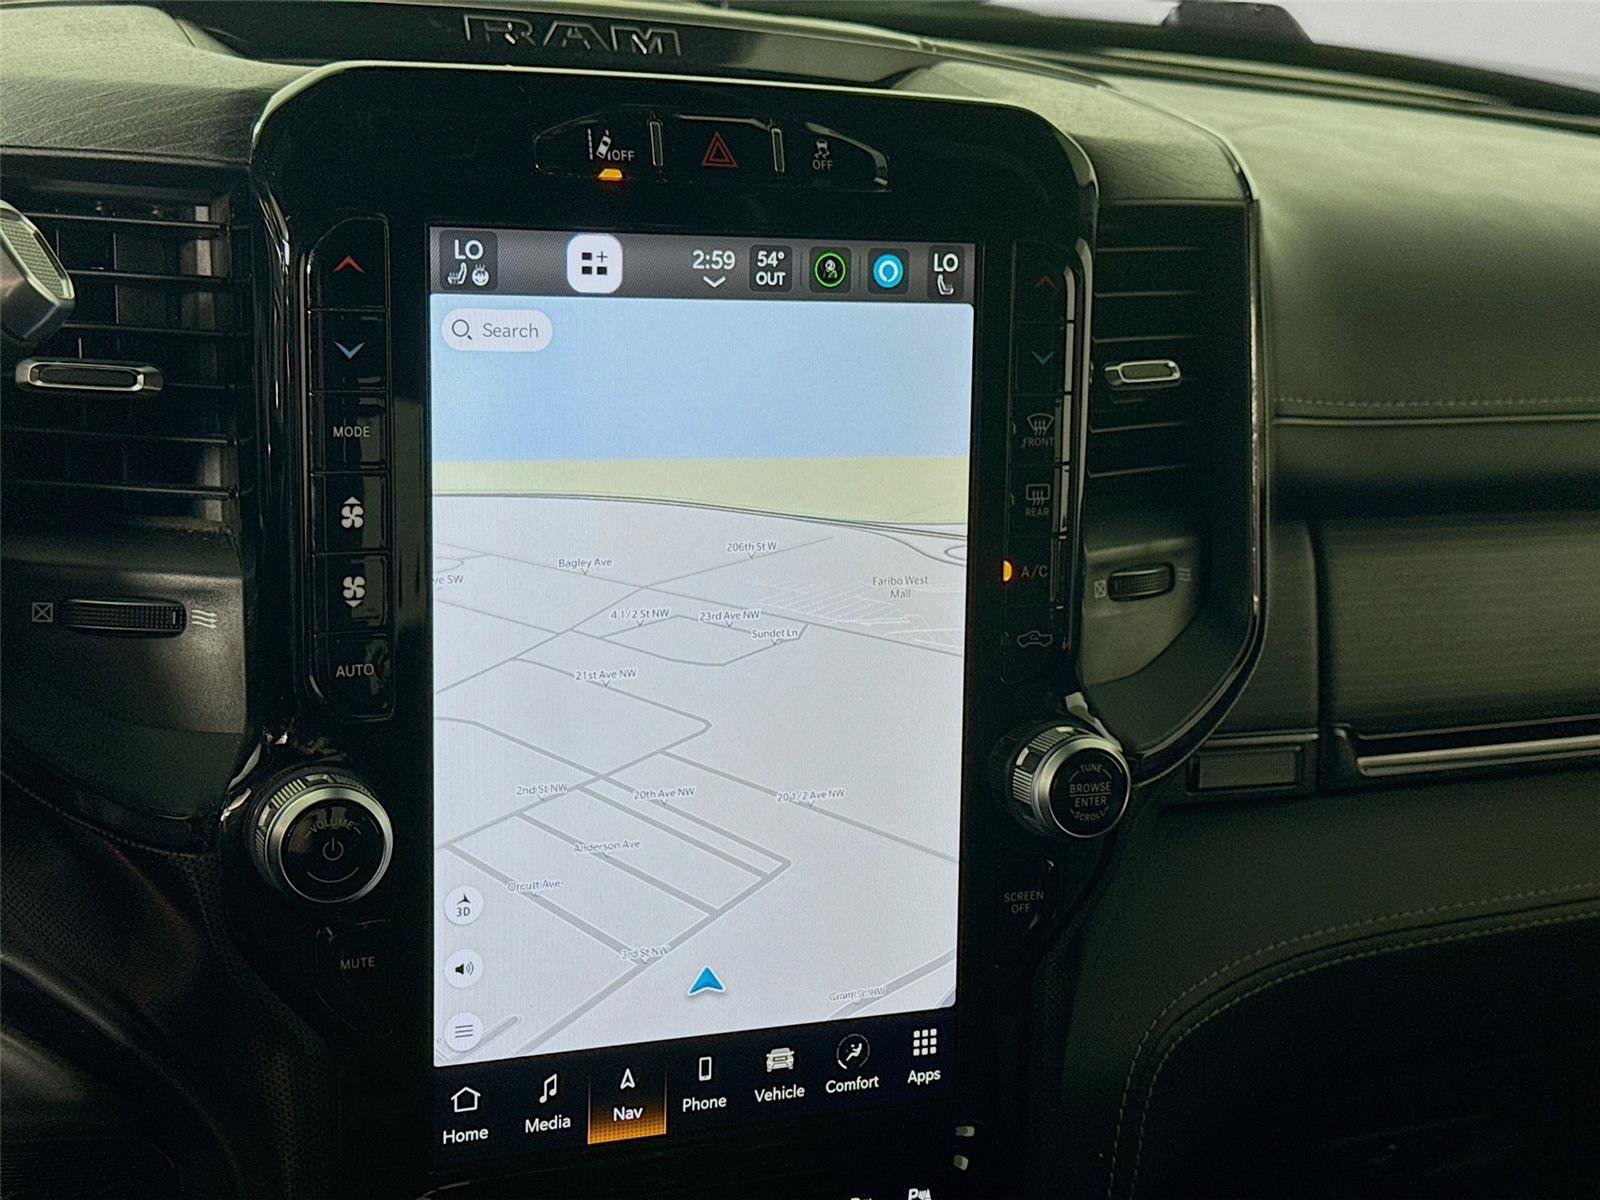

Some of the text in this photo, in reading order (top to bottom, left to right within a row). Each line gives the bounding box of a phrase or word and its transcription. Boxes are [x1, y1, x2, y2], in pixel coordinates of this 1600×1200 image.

[463, 14, 682, 57] RAM
[612, 150, 635, 161] OFF
[812, 158, 834, 170] OFF
[454, 239, 484, 260] LO
[692, 249, 736, 271] 2:59
[756, 250, 785, 268] 54°
[933, 252, 959, 273] LO
[755, 271, 786, 287] OUT
[482, 321, 540, 340] Search
[332, 426, 371, 438] MODE
[1023, 437, 1054, 448] FRONT
[1025, 507, 1050, 518] REAR
[726, 541, 778, 553] 206th St W
[558, 557, 613, 569] Bagley Ave
[1021, 565, 1049, 579] A/C
[447, 574, 464, 585] SW
[872, 575, 929, 587] Faribo West
[890, 588, 911, 599] Mall
[640, 608, 651, 620] St
[652, 608, 670, 618] NW
[699, 610, 760, 622] 23rd Ave NW
[787, 628, 799, 638] Ln
[335, 664, 375, 678] AUTO
[575, 669, 637, 681] 21st Ave NW
[1079, 764, 1103, 775] TUNE
[516, 784, 568, 796] 2nd St NW
[634, 787, 695, 800] 20th Ave NW
[809, 790, 827, 800] Ave
[828, 789, 845, 799] NW
[1069, 781, 1112, 795] BROWSE
[1075, 796, 1107, 808] ENTER
[309, 817, 354, 833] VOLUME
[573, 840, 641, 853] Anderson Ave
[1003, 890, 1044, 904] SCREEN
[455, 906, 471, 918] 3D
[1011, 903, 1031, 914] OFF
[340, 956, 376, 970] MUTE
[907, 1068, 942, 1086] Apps
[825, 1075, 880, 1094] Comfort
[754, 1083, 806, 1104] Vehicle
[682, 1093, 727, 1113] Phone
[613, 1105, 643, 1123] Nav
[524, 1114, 571, 1134] Media
[442, 1125, 489, 1145] Home
